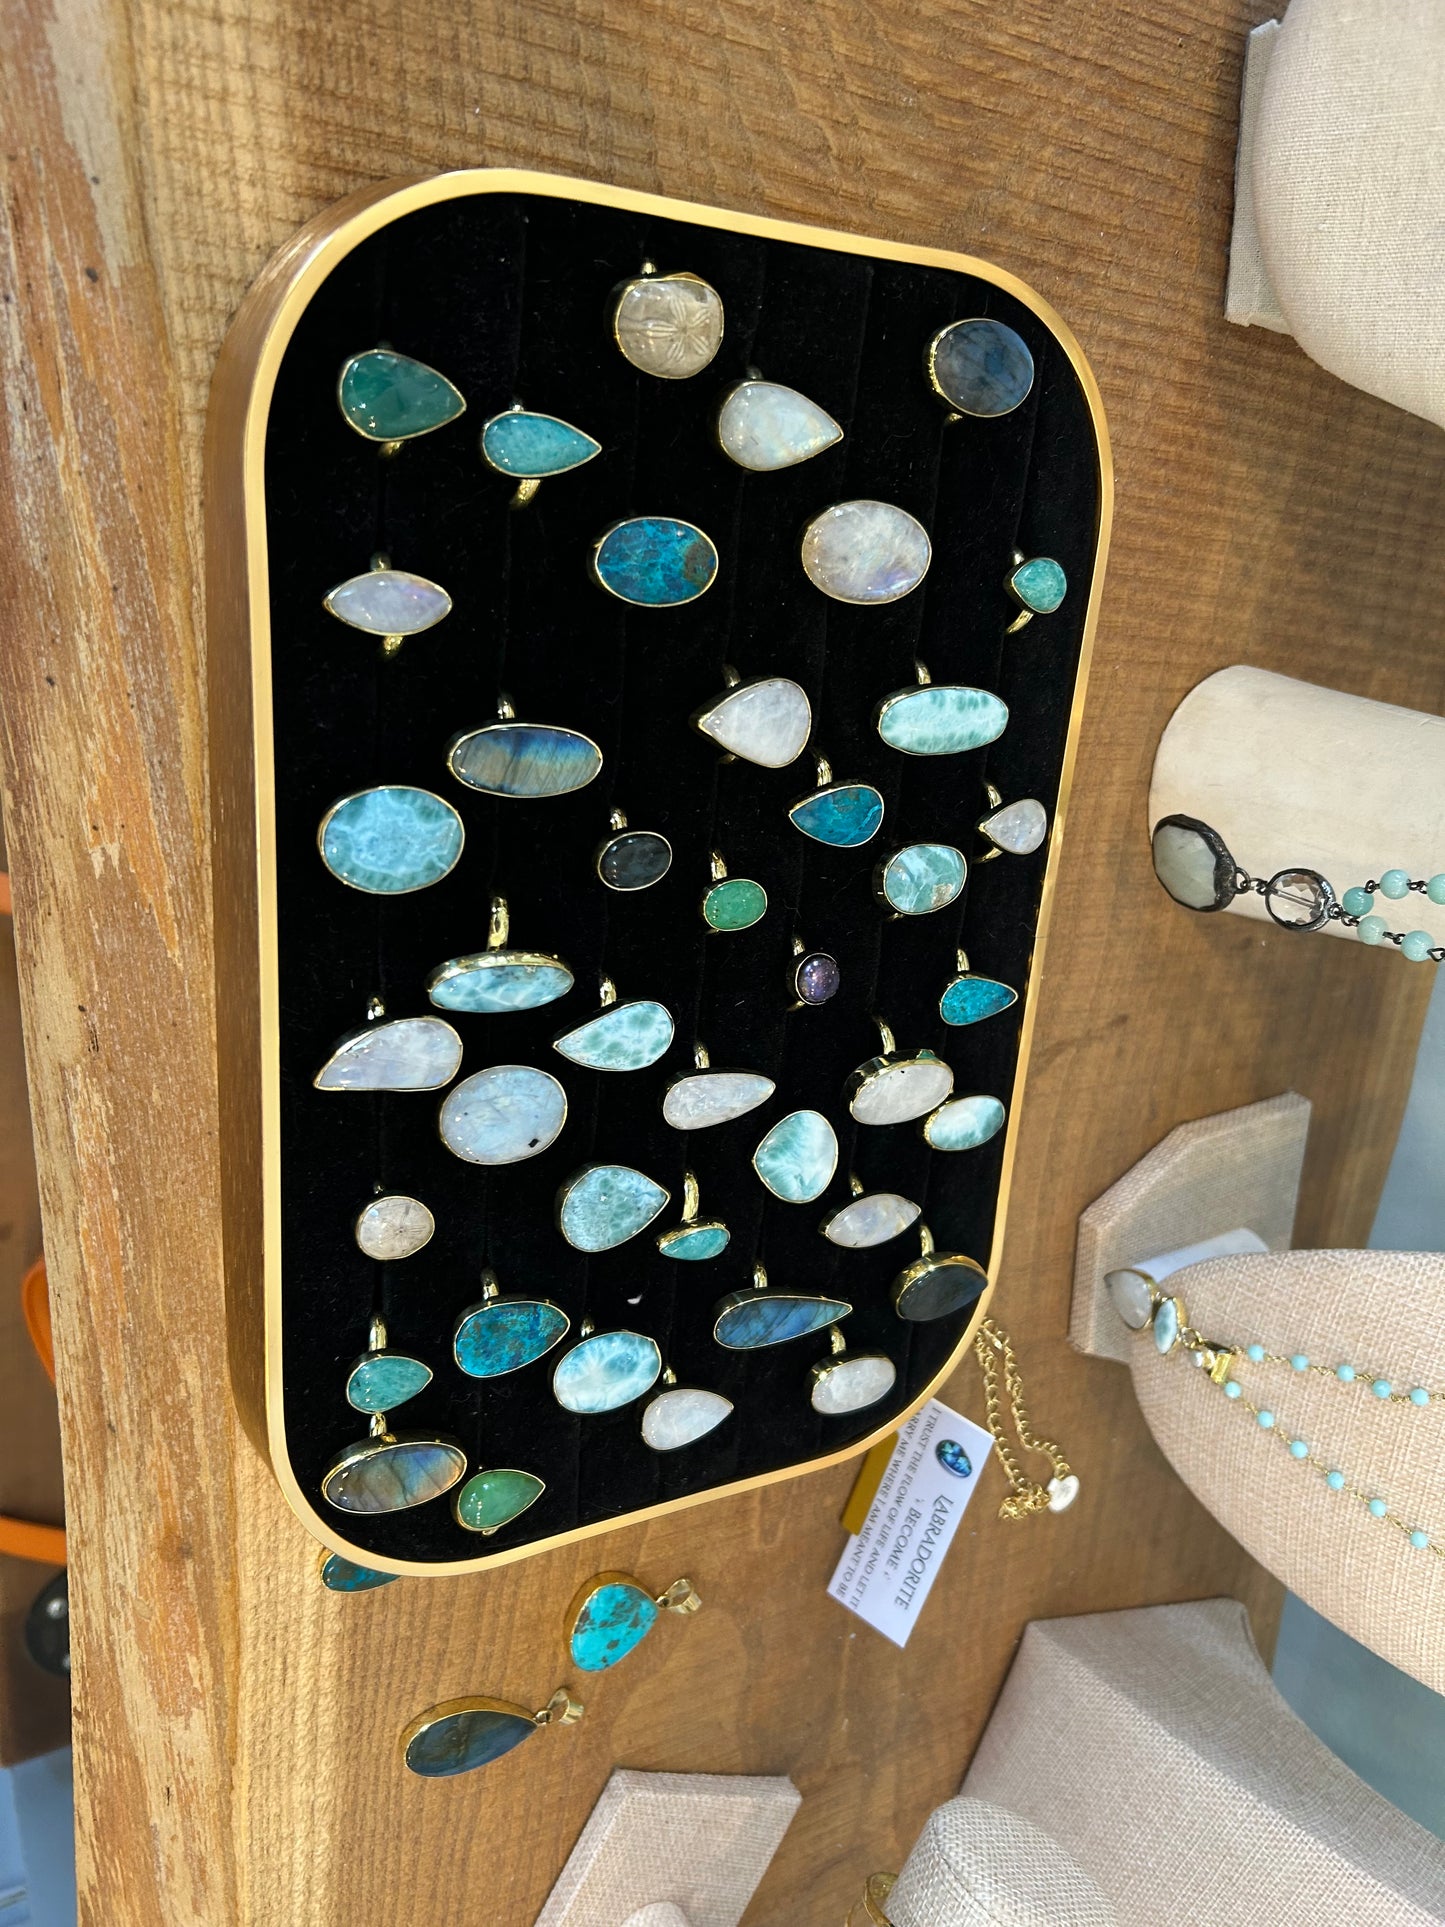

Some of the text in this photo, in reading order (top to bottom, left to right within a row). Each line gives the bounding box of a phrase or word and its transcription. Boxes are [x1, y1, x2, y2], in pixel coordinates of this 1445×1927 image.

[904, 1407, 923, 1439] RRY
[918, 1415, 938, 1450] TRUST
[896, 1439, 909, 1457] ME
[907, 1451, 922, 1473] THE
[881, 1459, 902, 1498] WHERE
[895, 1473, 913, 1507] FLOW
[869, 1503, 880, 1523] AM
[886, 1507, 899, 1524] OF
[851, 1523, 873, 1565] MEANT
[875, 1523, 892, 1548] LIFE
[886, 1507, 922, 1570] BECOME
[865, 1547, 880, 1575] AND
[894, 1494, 954, 1610] LABRADORITE
[843, 1566, 855, 1582] TO
[856, 1575, 870, 1596] LET
[836, 1582, 848, 1598] BE
[849, 1595, 860, 1609] IT
